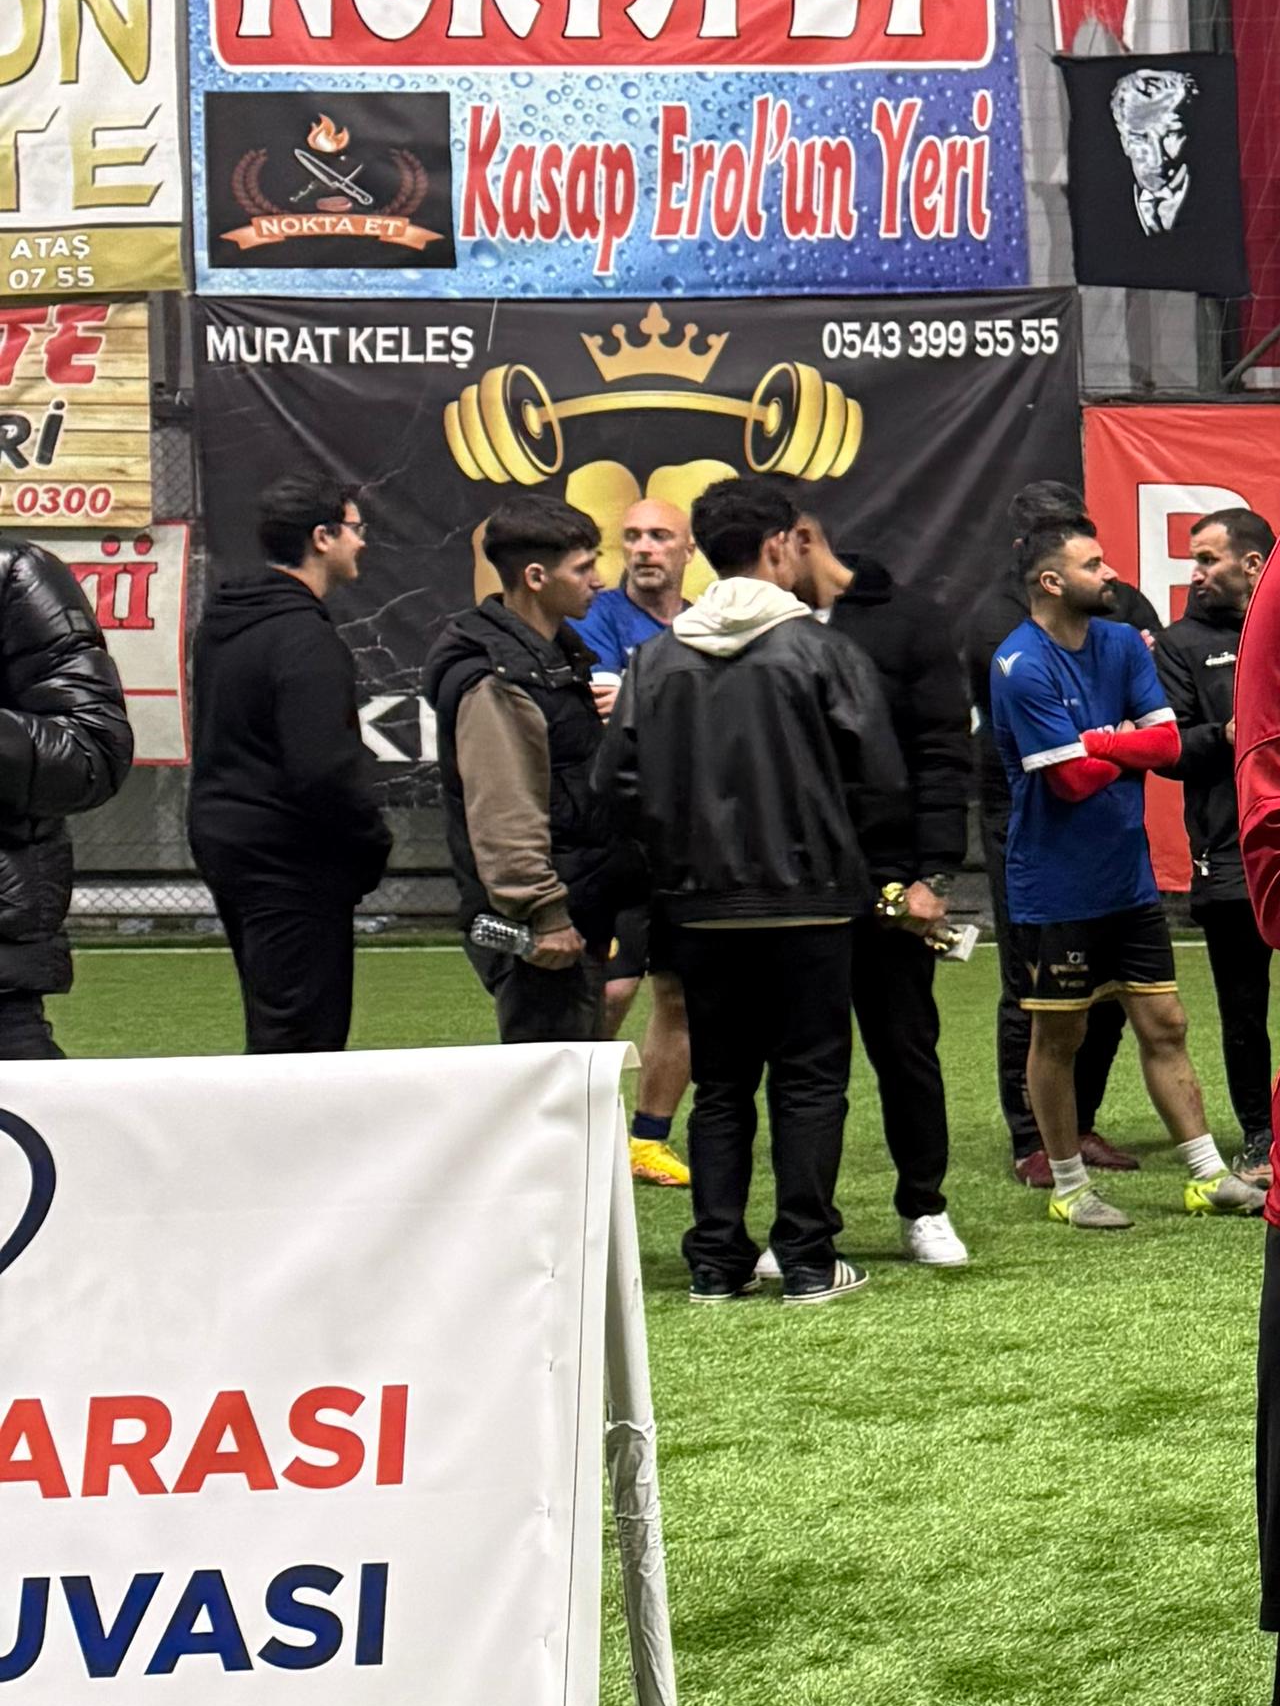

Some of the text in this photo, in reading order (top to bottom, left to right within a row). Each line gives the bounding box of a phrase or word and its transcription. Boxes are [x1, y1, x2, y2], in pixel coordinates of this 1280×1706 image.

[460, 90, 993, 275] Kasap Erol'un Yeri
[259, 214, 406, 237] NOKTA ET
[10, 234, 91, 261] ATAŞ
[9, 266, 96, 290] 07 55
[206, 324, 475, 369] MURAT KELEŞ
[823, 317, 1060, 359] 0543 399 55 55
[16, 486, 112, 515] 0300
